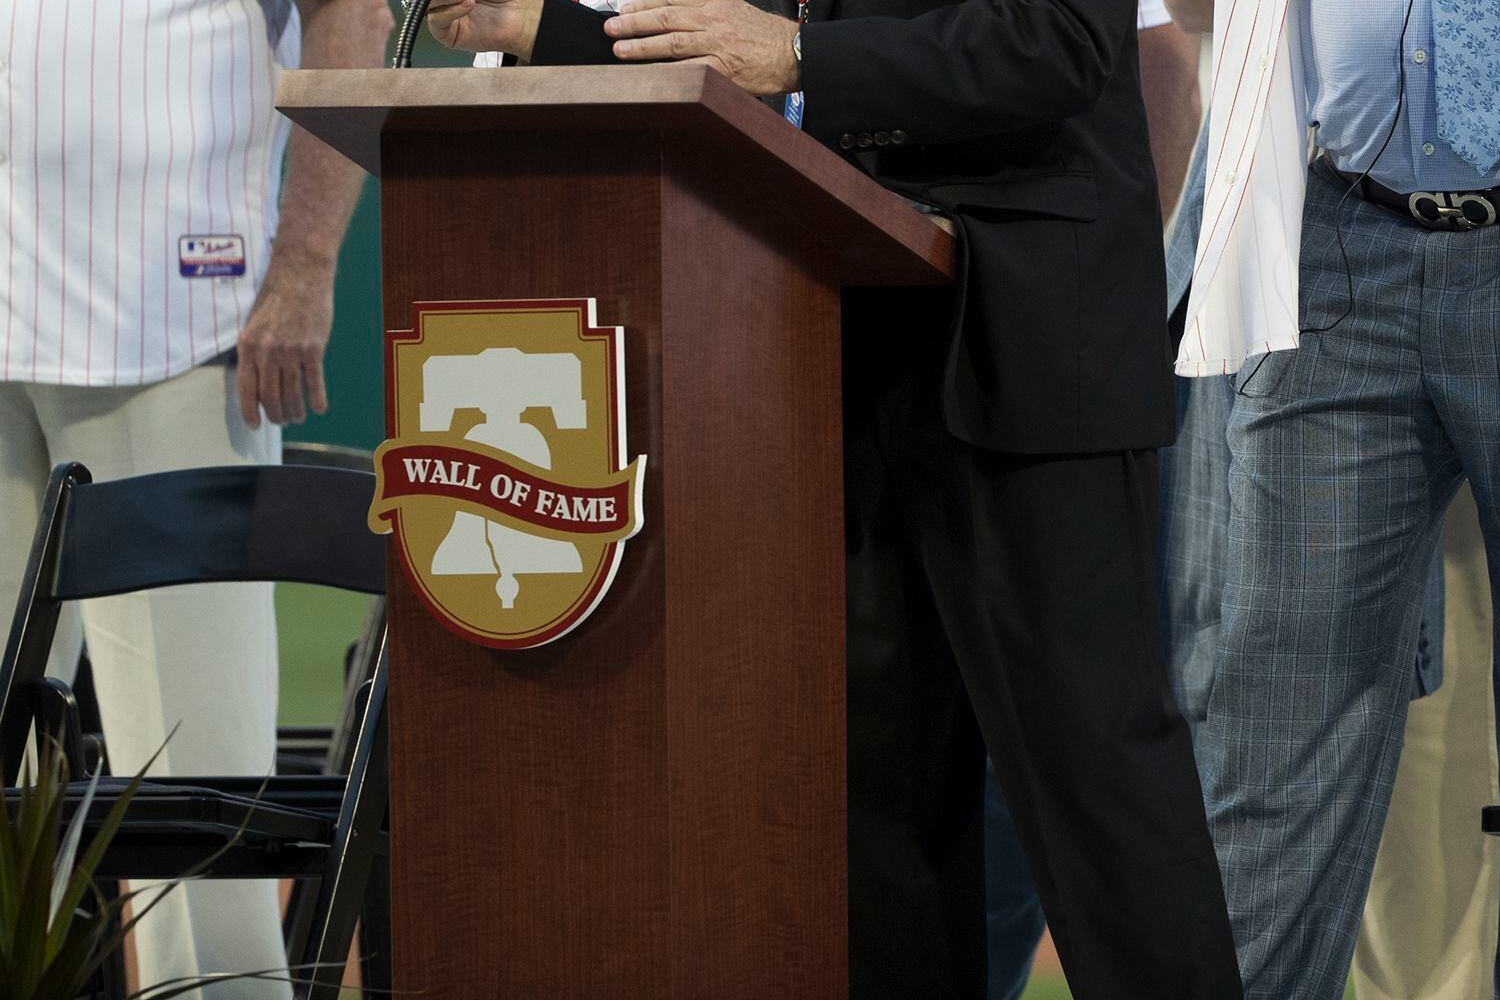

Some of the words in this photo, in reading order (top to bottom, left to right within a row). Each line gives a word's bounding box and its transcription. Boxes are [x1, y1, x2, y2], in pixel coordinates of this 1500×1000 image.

[402, 458, 481, 491] WALL
[490, 474, 531, 507] OF
[534, 489, 618, 522] FAME
